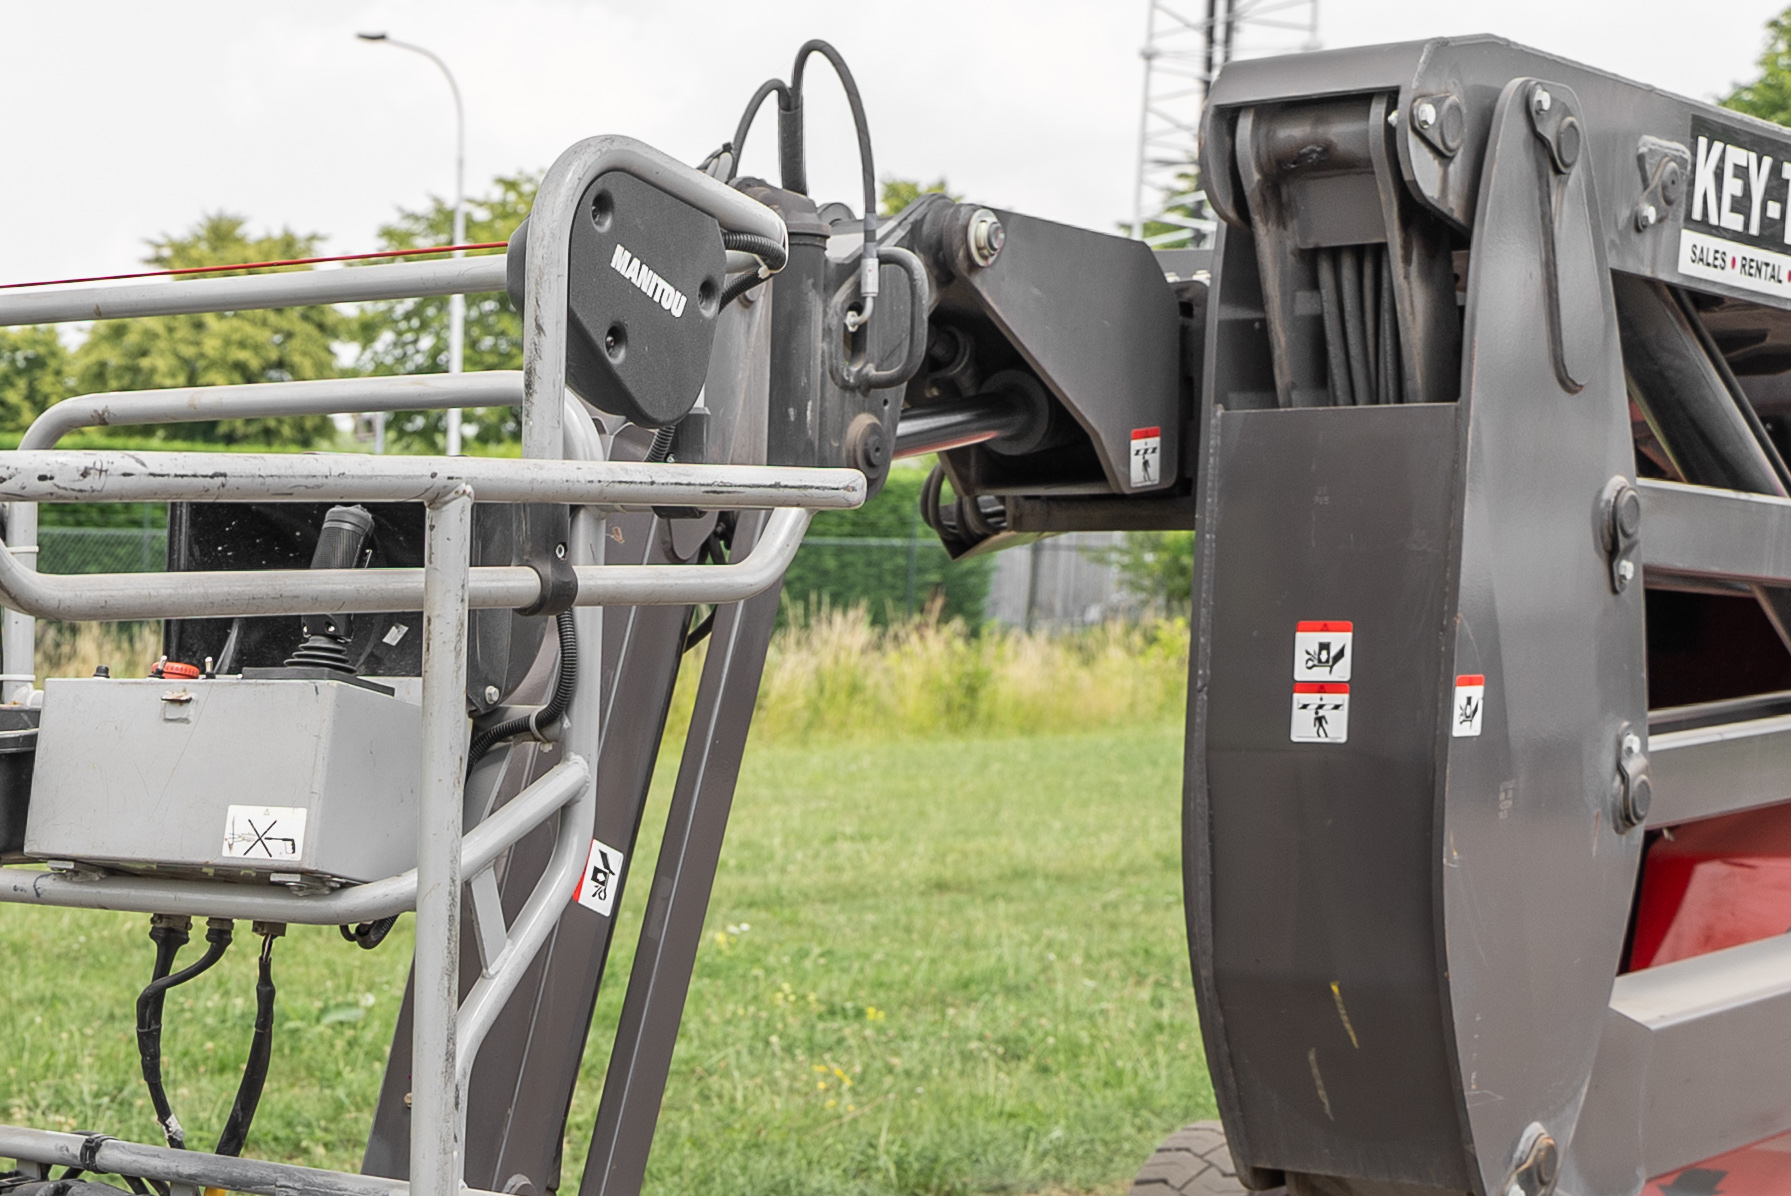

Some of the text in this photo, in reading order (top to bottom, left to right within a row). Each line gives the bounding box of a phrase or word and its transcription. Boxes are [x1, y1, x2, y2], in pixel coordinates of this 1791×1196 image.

[610, 243, 688, 318] MANITOU
[1690, 244, 1783, 284] SALES RENTAL
